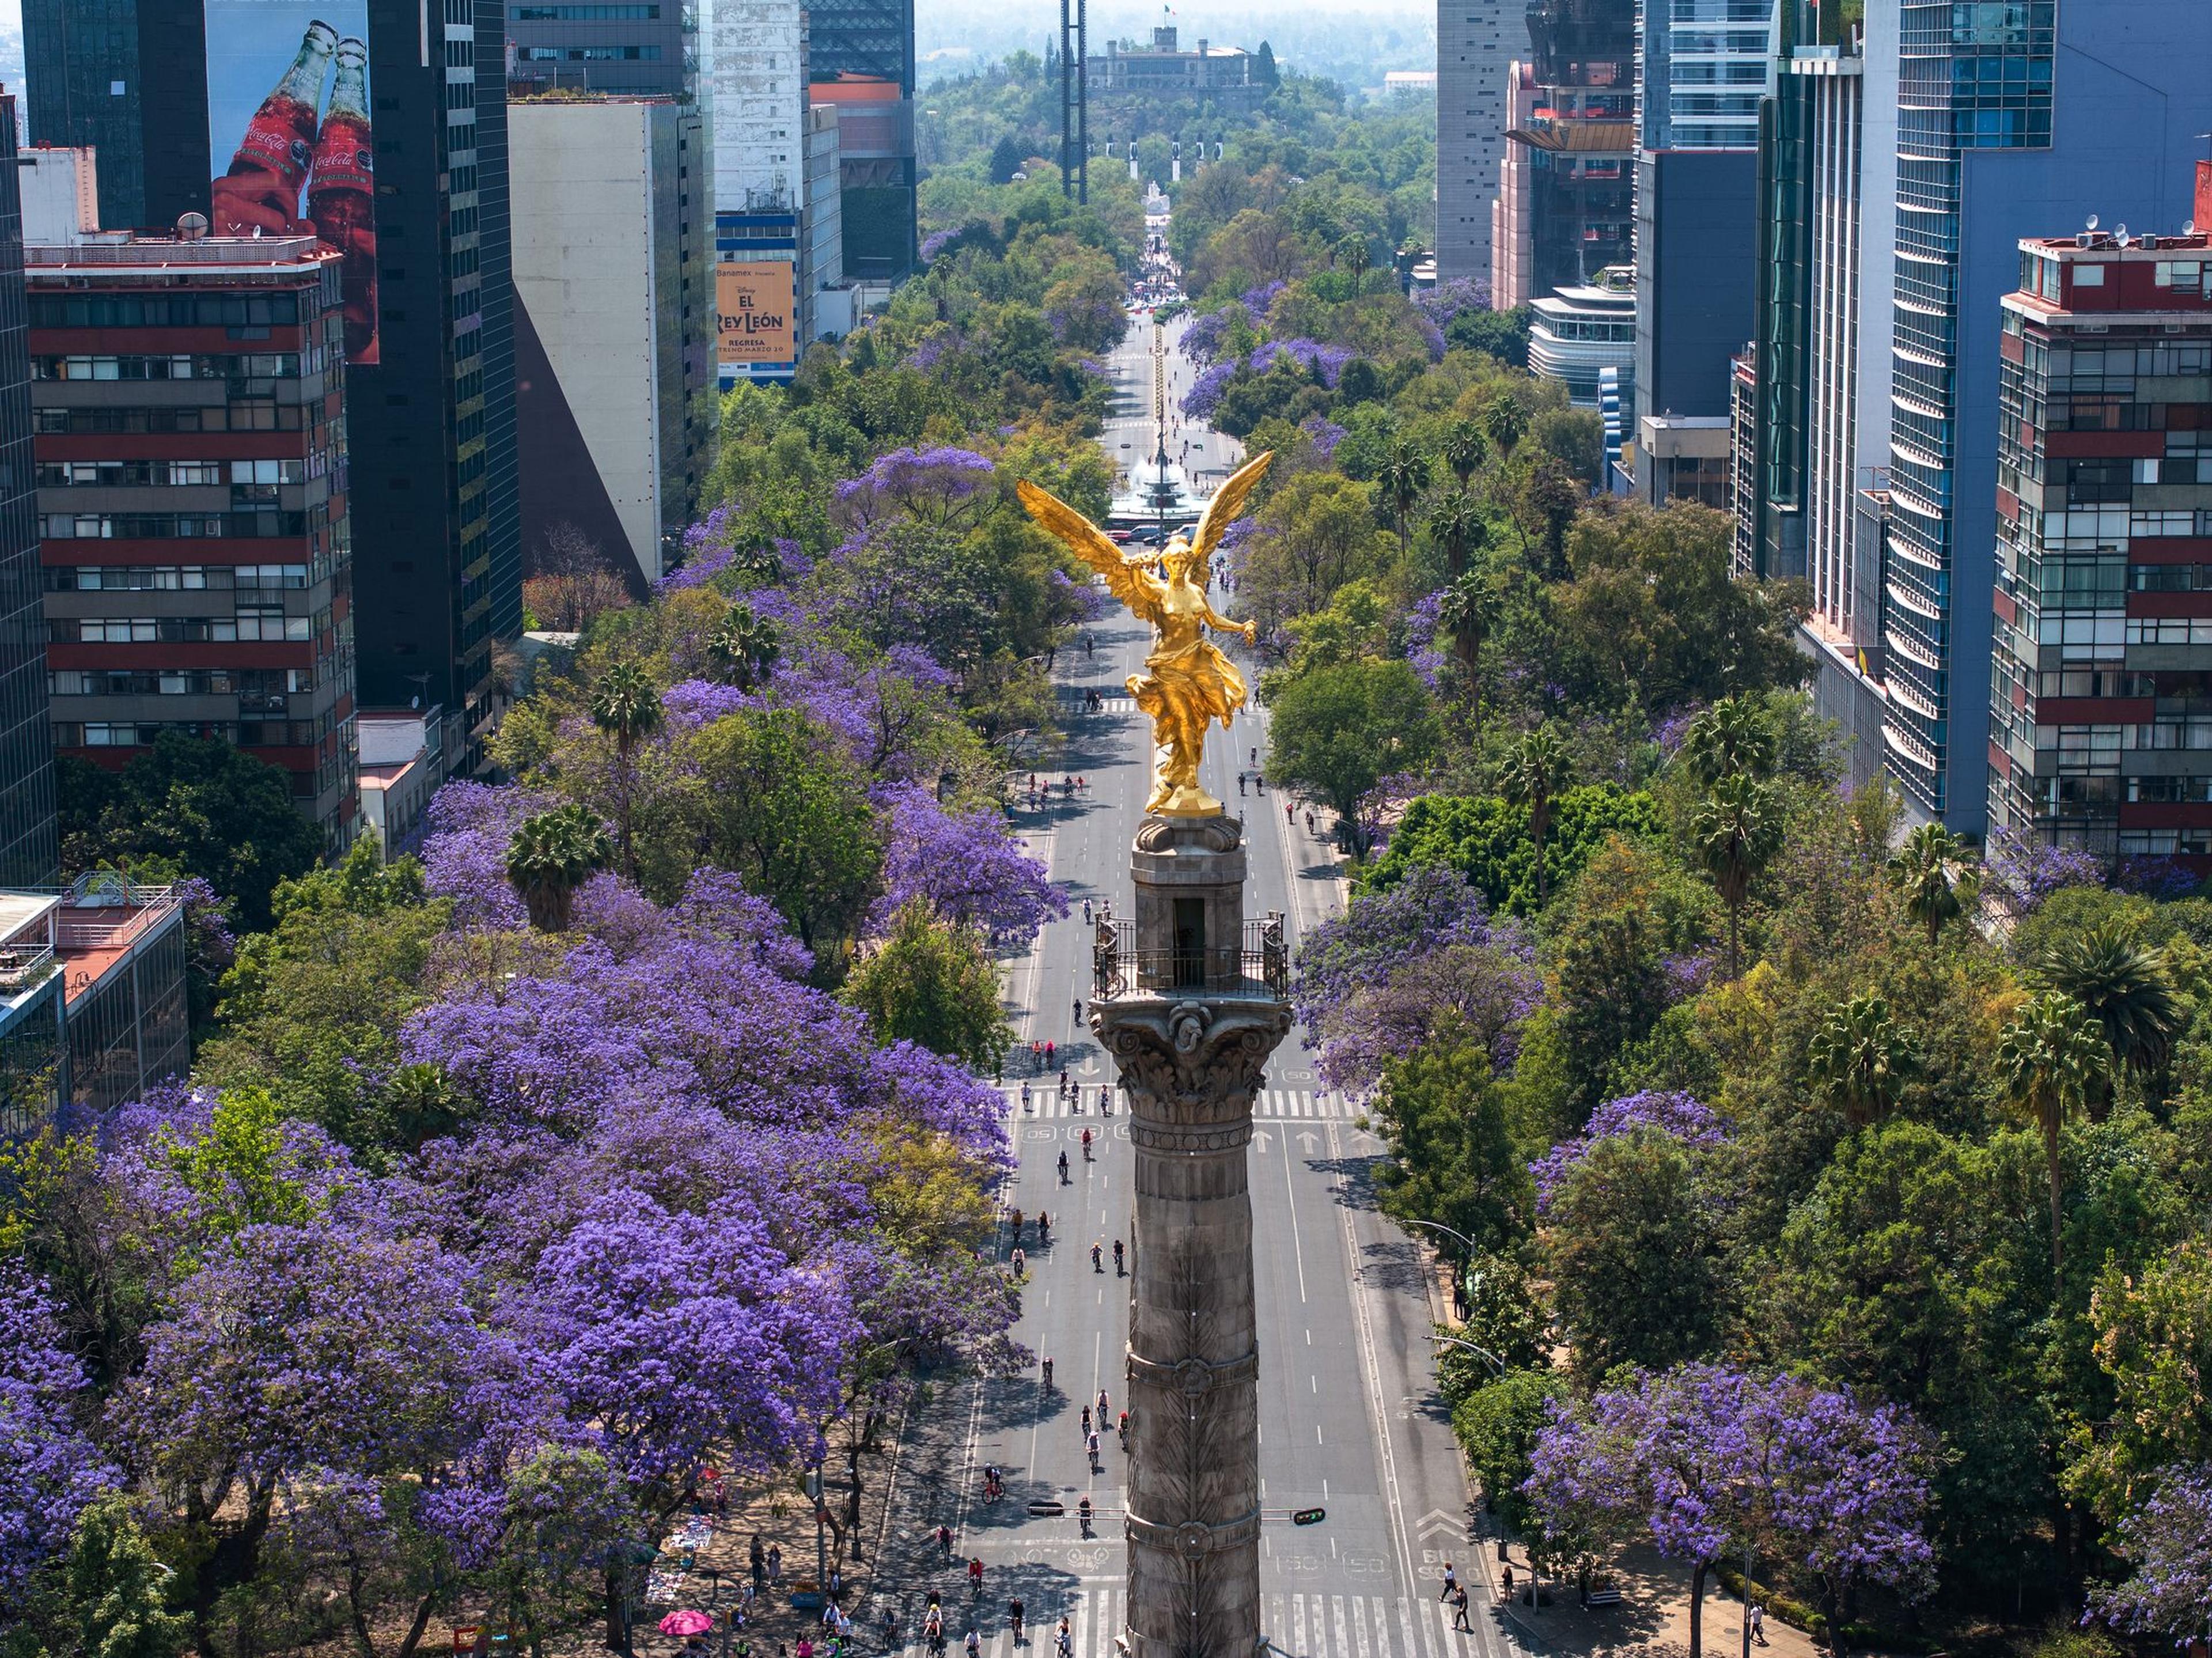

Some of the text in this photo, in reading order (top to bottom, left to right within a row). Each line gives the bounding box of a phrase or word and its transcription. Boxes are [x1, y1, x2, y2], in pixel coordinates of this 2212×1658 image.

[740, 296, 754, 307] EL
[745, 312, 782, 334] LEÓN
[1422, 1549, 1470, 1564] BUS
[1418, 1566, 1481, 1581] SOO
